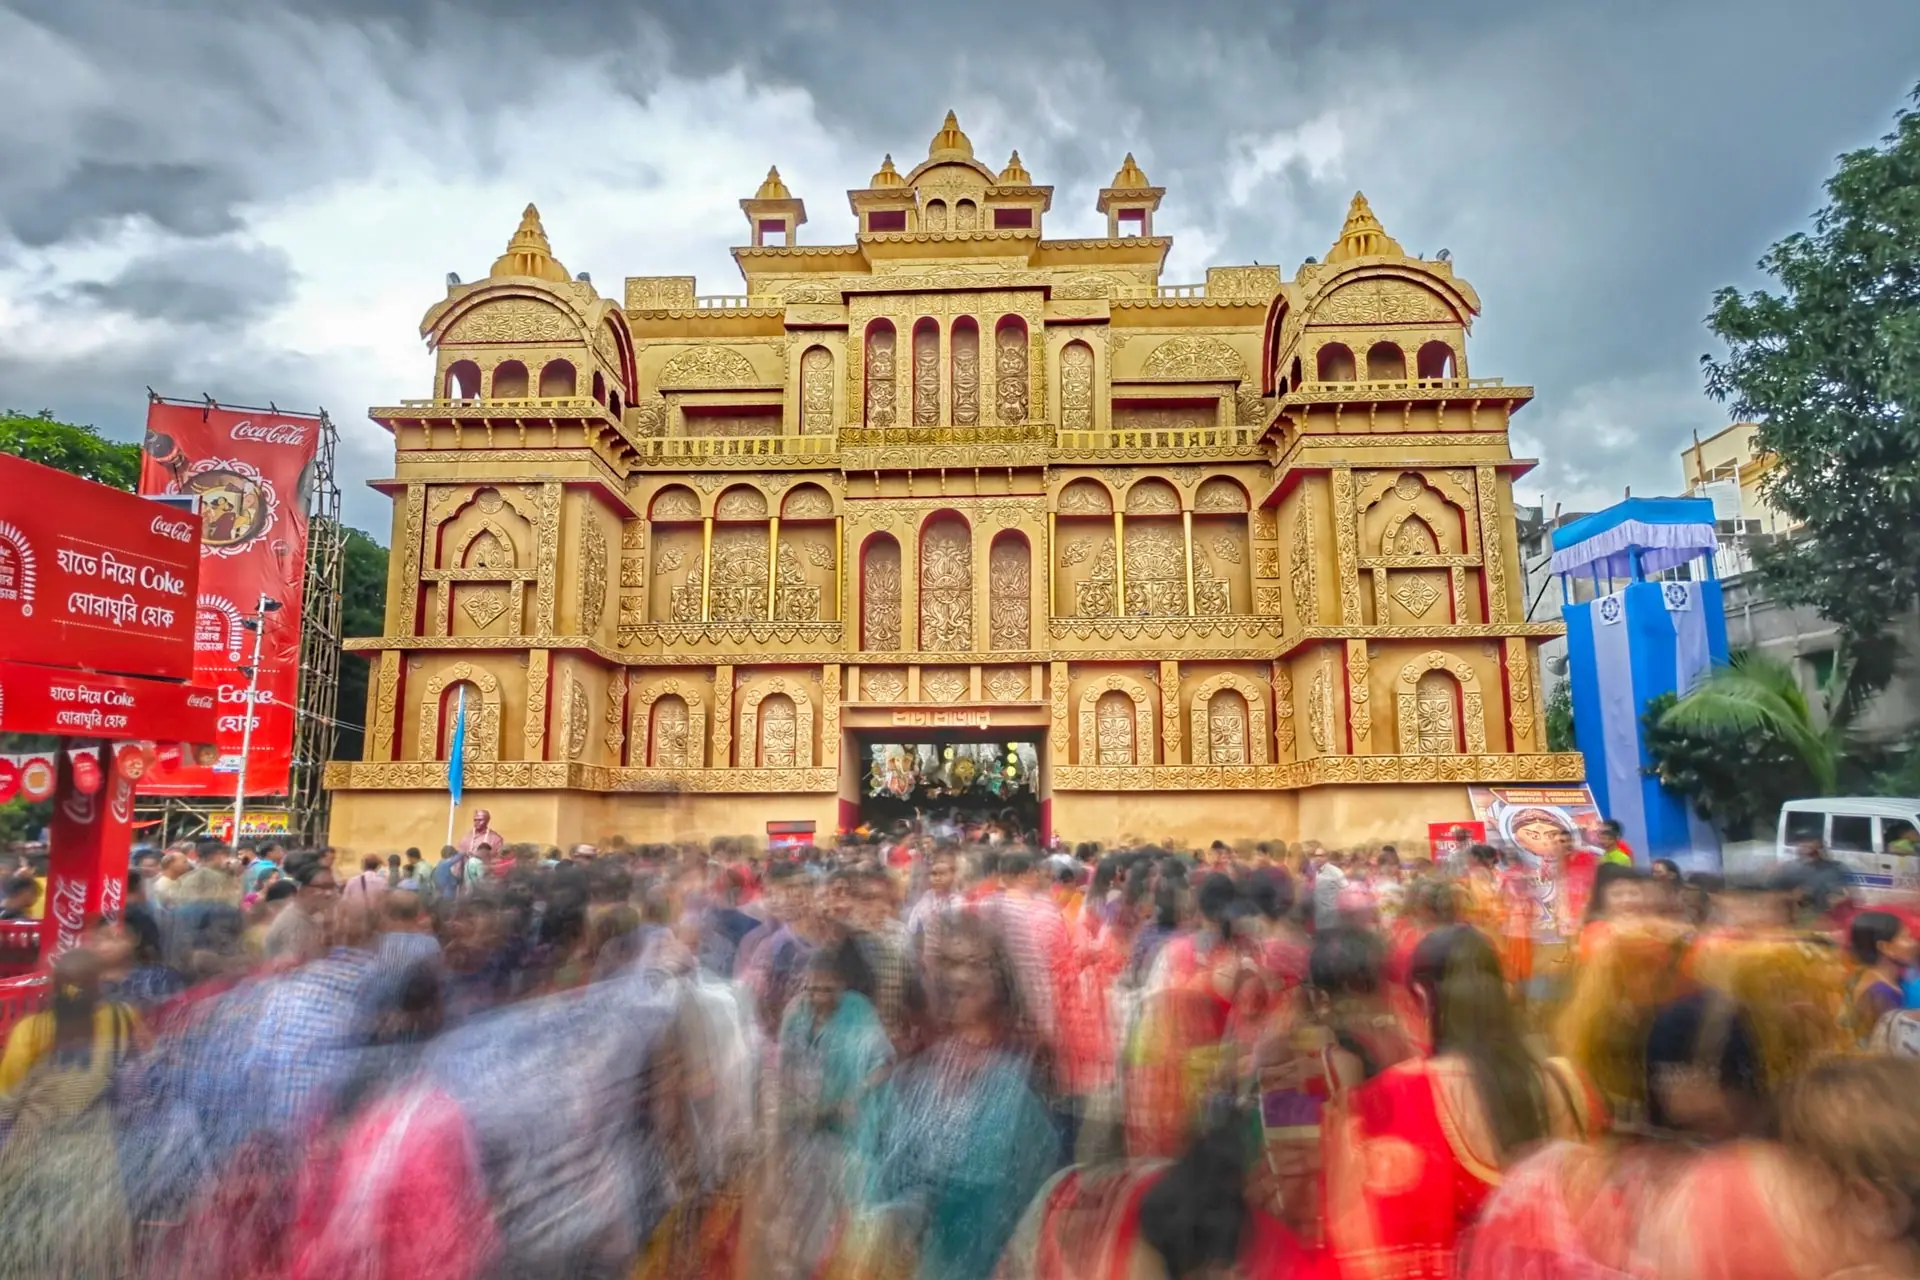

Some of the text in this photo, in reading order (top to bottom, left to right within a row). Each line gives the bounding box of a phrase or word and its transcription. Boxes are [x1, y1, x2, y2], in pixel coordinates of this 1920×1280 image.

[56, 548, 185, 595] হাতে নিয়ে Coke
[67, 592, 175, 629] ঘোরাঘুরি হোক
[50, 685, 136, 707] হাতে নিয়ে Coke
[56, 709, 128, 729] ঘোরাঘুরি হোক
